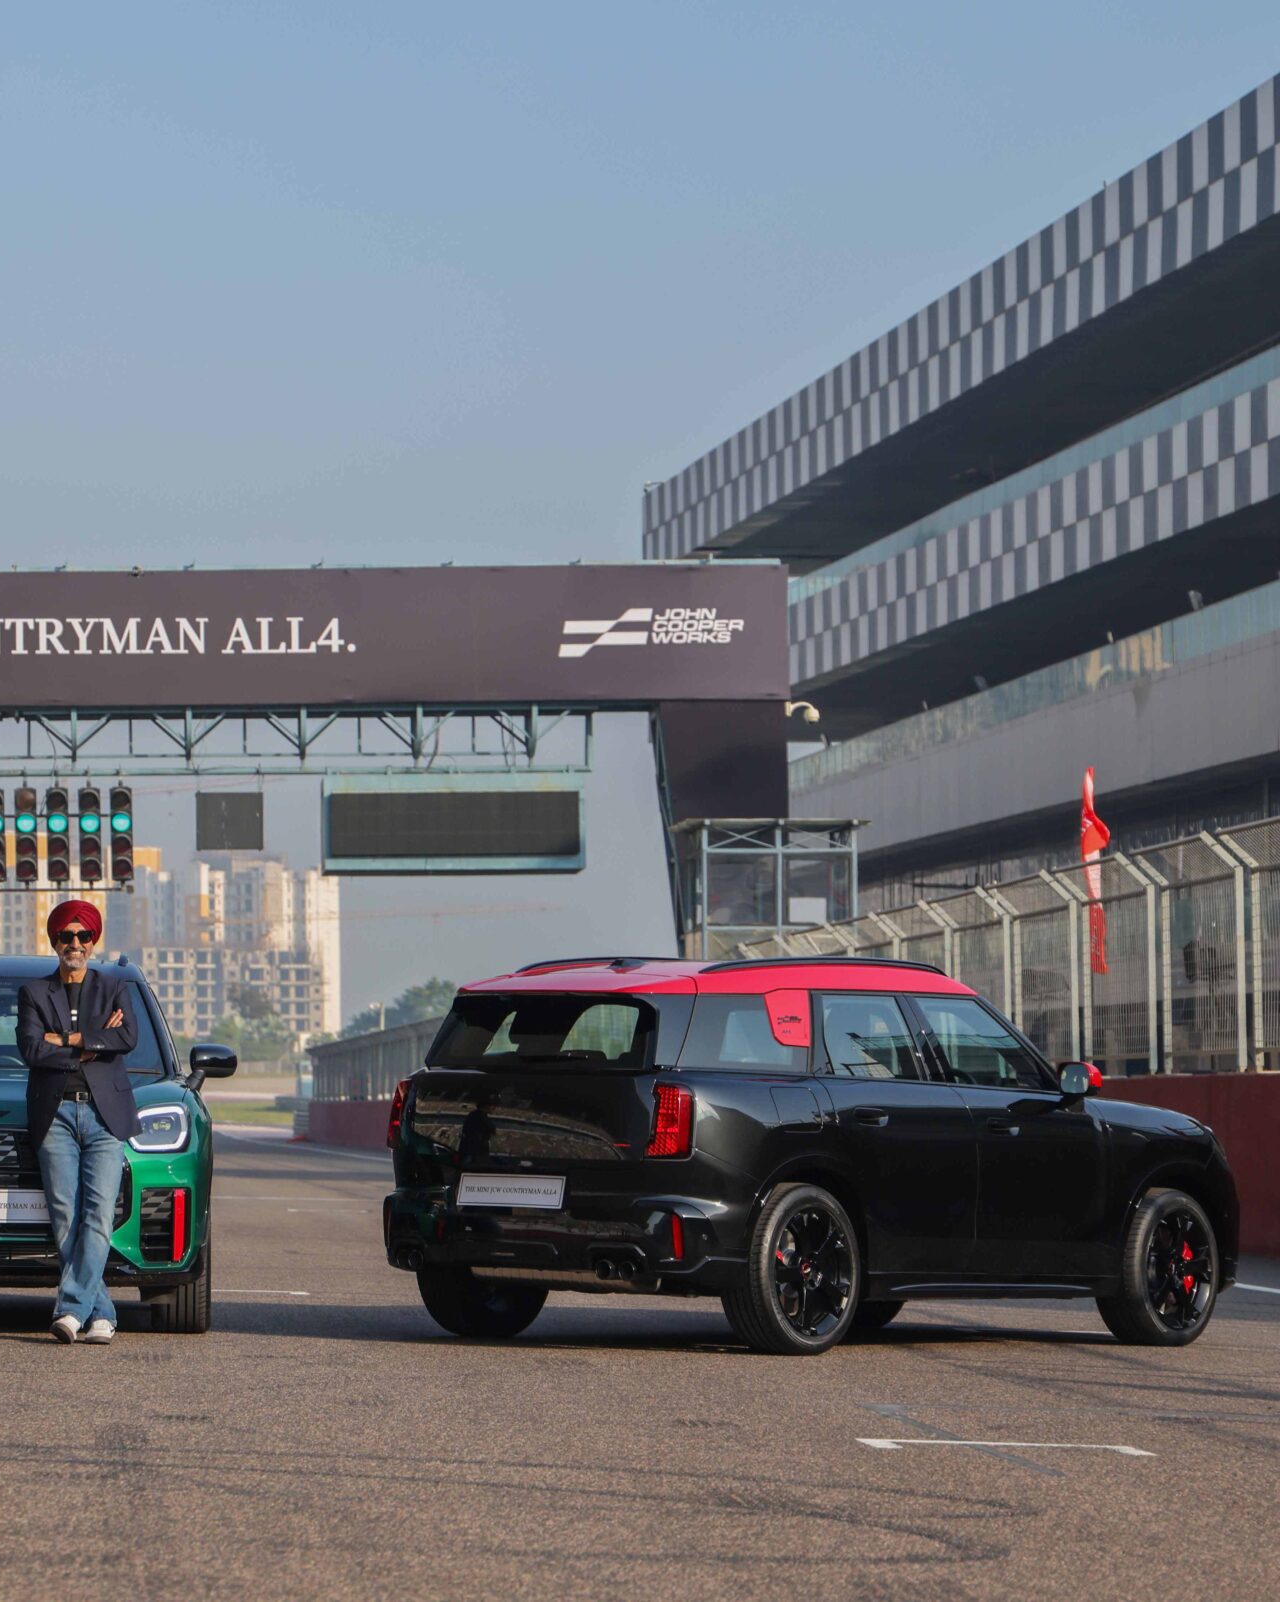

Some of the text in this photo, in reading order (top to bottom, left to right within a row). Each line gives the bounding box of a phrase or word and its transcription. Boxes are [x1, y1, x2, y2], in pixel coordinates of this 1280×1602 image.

[654, 607, 717, 620] JOHN
[652, 619, 745, 632] COOPER
[221, 617, 357, 654] ALL4.
[650, 631, 732, 645] WORKS
[489, 1186, 501, 1195] JCW
[502, 1187, 541, 1195] COUNTRYMAN
